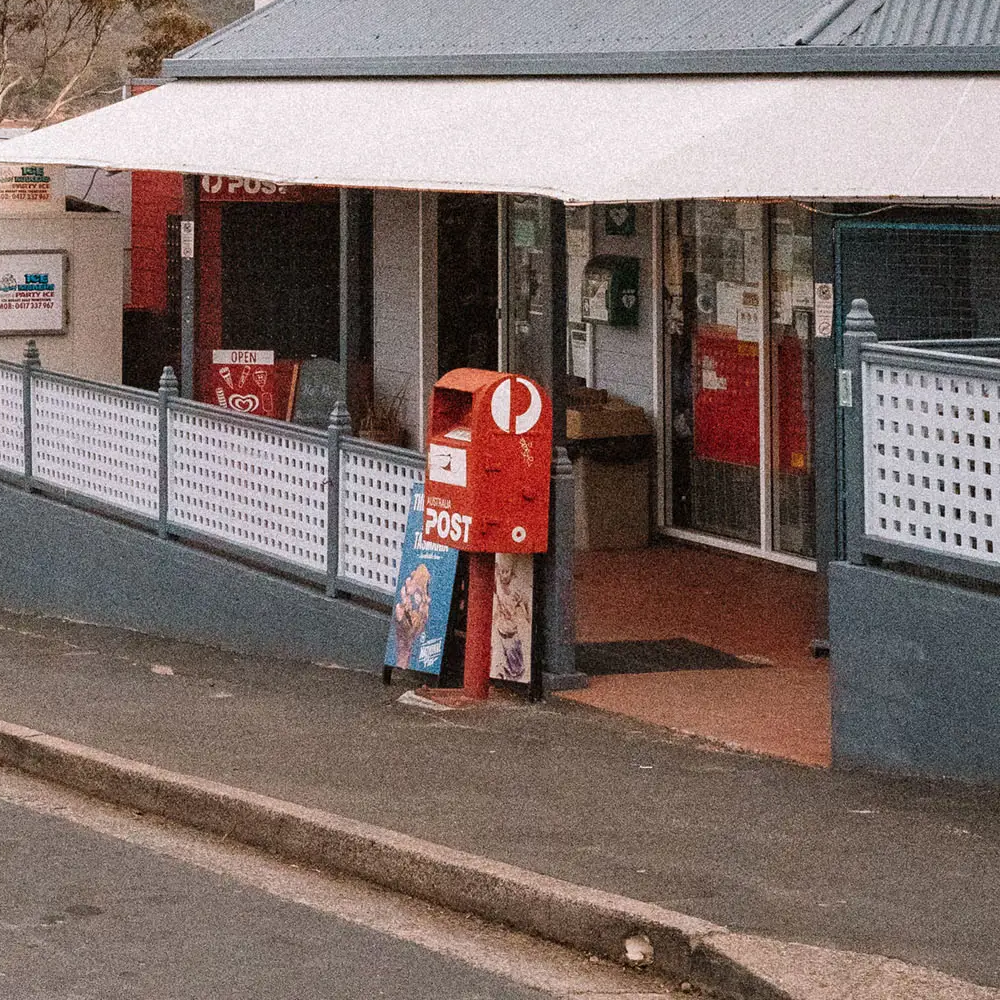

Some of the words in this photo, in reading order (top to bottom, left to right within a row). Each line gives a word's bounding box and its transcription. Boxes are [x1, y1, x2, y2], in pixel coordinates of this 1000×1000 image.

[24, 273, 48, 284] ICE
[231, 351, 257, 364] OPEN
[426, 496, 452, 509] AUSTRALIA
[425, 508, 473, 543] POST
